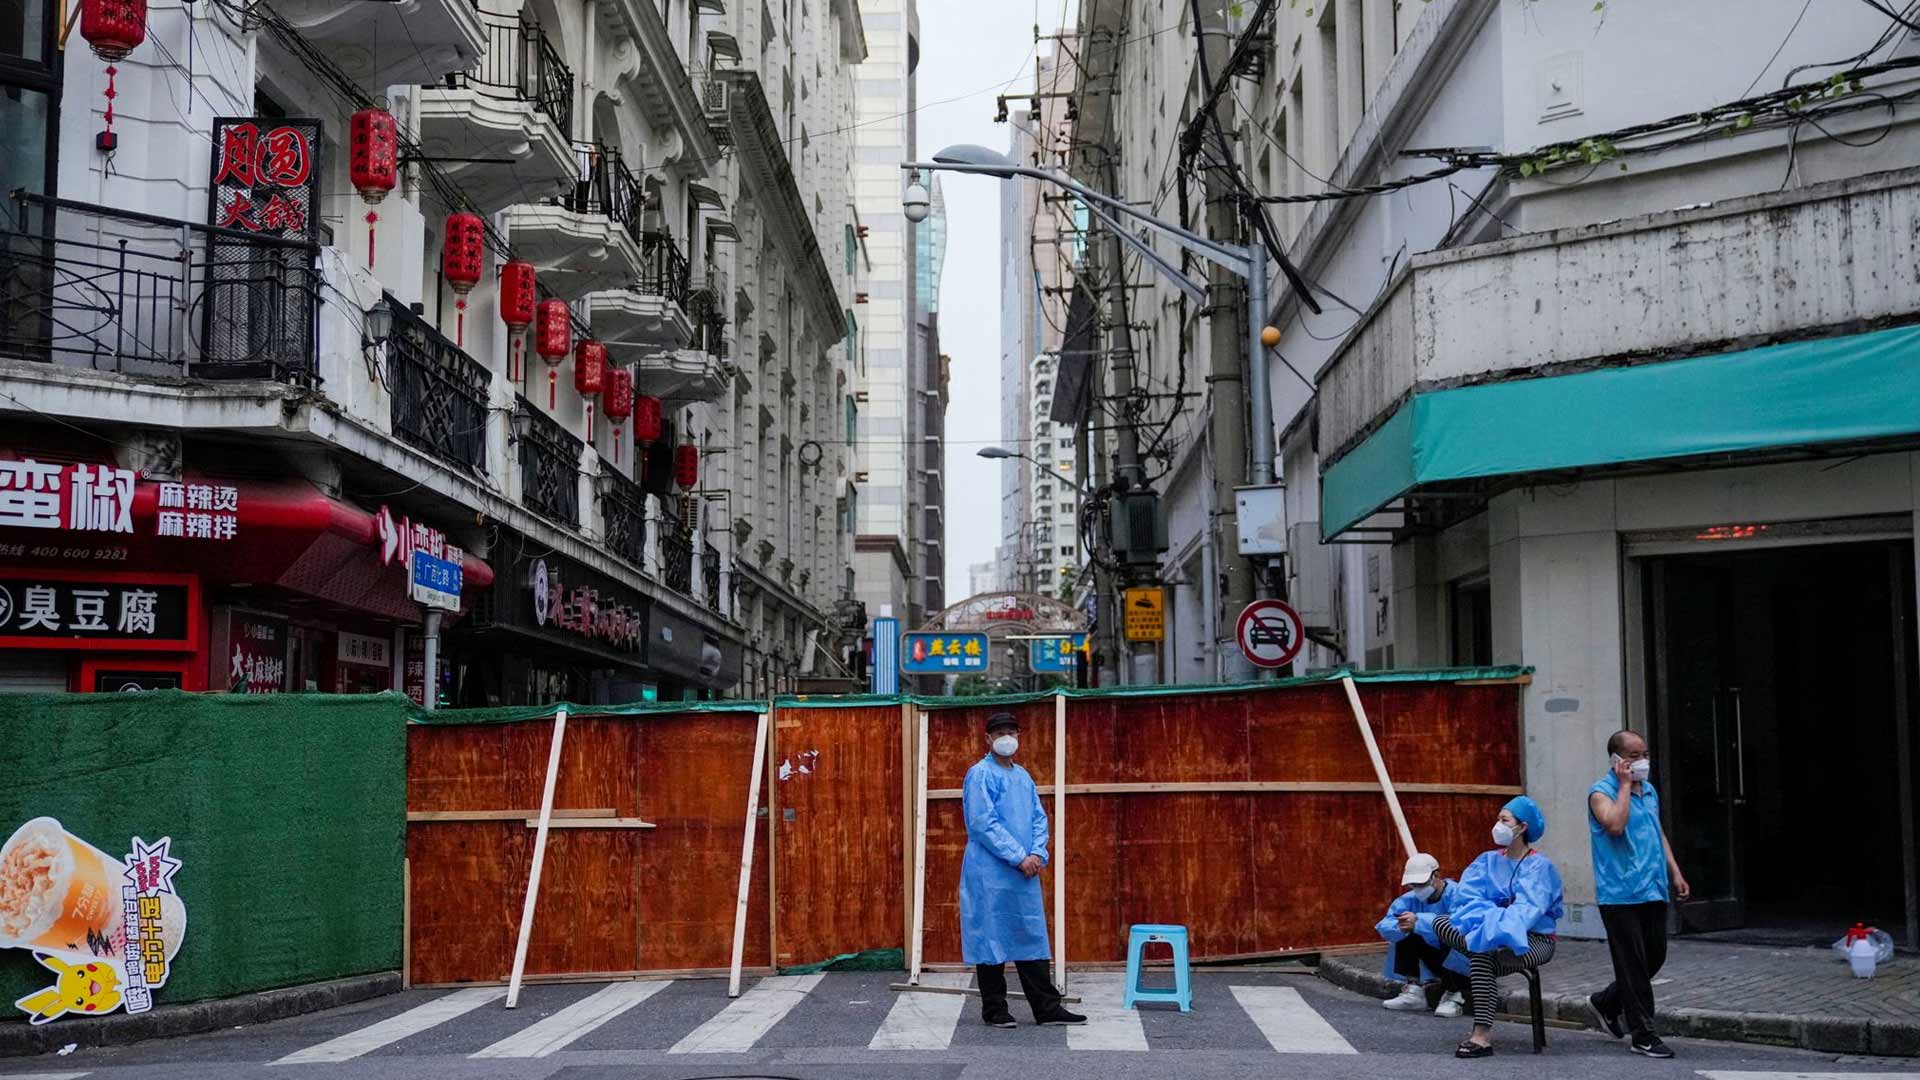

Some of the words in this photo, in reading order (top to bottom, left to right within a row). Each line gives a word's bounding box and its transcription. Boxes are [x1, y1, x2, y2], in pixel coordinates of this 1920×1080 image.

[214, 122, 310, 187] 月圆
[217, 191, 304, 231] 火锅
[0, 458, 135, 534] 蛮椒
[158, 482, 238, 512] 麻辣烫
[157, 512, 238, 540] 麻辣拌
[30, 546, 59, 558] 400
[63, 548, 90, 559] 600
[94, 548, 129, 560] 9281
[19, 583, 158, 635] 臭豆腐
[139, 896, 165, 984] 电力十足
